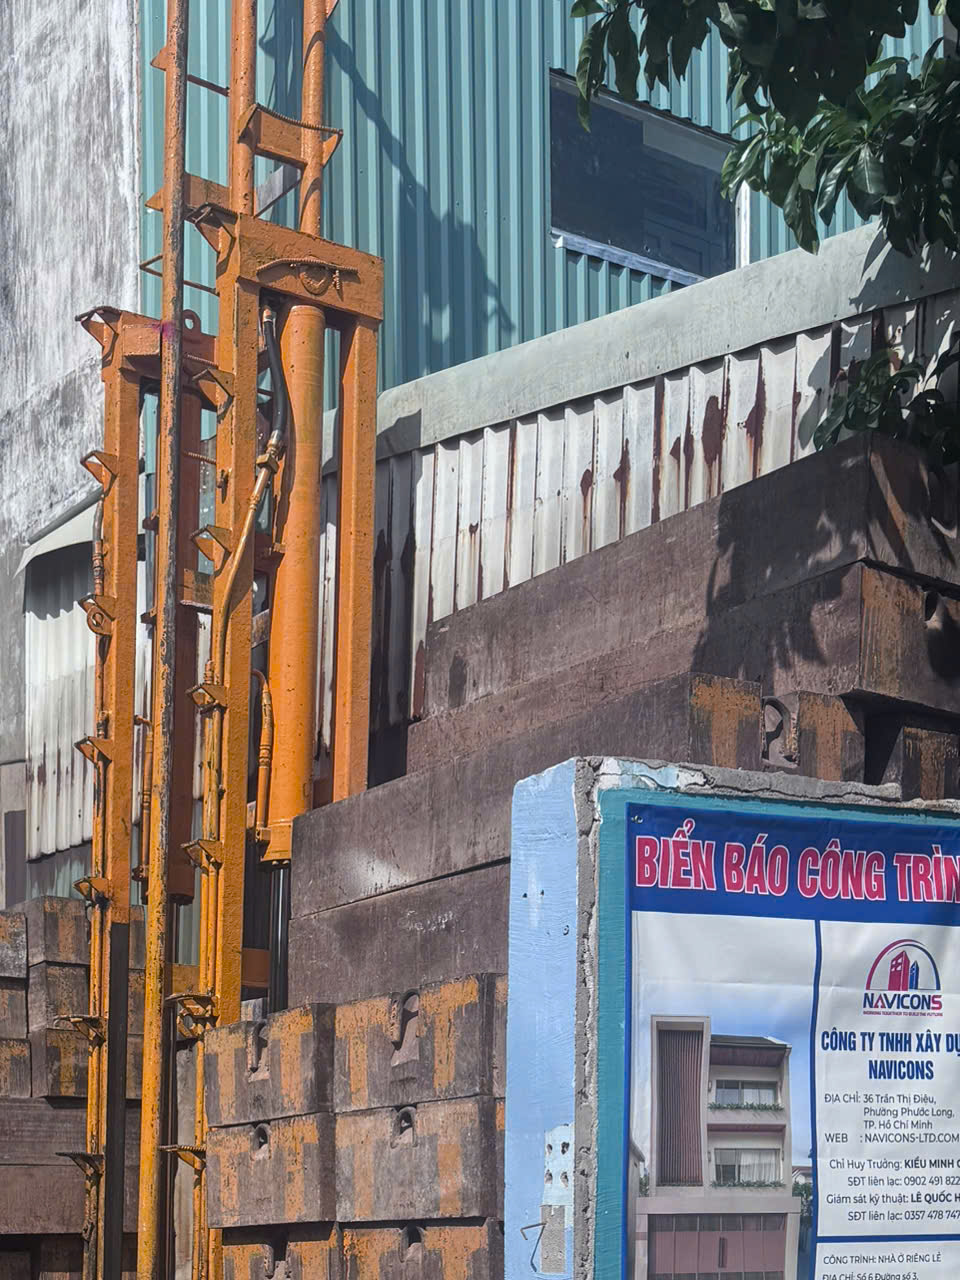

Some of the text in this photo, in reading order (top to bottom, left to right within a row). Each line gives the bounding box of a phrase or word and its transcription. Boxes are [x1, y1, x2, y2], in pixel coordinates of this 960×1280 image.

[635, 818, 716, 891] BIỂN
[723, 833, 789, 896] BÁO
[796, 839, 887, 901] CÔNG
[863, 993, 943, 1011] NAVICONS
[821, 1027, 856, 1051] CÔNG
[860, 1032, 875, 1052] TY
[879, 1032, 912, 1052] TNHH
[916, 1029, 941, 1052] XÂY
[868, 1060, 934, 1080] NAVICONS
[824, 1091, 936, 1105] ĐỊA CHỈ: 36 Trần Thị Điệu,
[863, 1107, 955, 1118] Phường Phước Long,
[863, 1120, 933, 1130] TP. Hồ Chí Minh
[825, 1133, 848, 1143] WEB
[829, 1158, 844, 1169] Chỉ
[847, 1159, 865, 1171] Huy
[929, 1159, 954, 1169] MINH
[847, 1176, 866, 1186] SĐT
[868, 1176, 884, 1186] liên
[886, 1176, 902, 1187] lạc:
[904, 1176, 926, 1185] 0902
[929, 1176, 943, 1185] 491
[826, 1193, 851, 1204] Giám
[853, 1193, 866, 1204] sát
[869, 1193, 880, 1206] kỹ
[881, 1194, 908, 1206] thuật:
[911, 1191, 921, 1203] LÊ
[924, 1190, 952, 1204] QUỐC
[847, 1211, 866, 1221] SĐT
[868, 1211, 885, 1221] liên
[887, 1211, 903, 1222] lạc:
[904, 1210, 925, 1221] 0357
[927, 1210, 943, 1220] 478
[823, 1254, 848, 1265] CÔNG
[878, 1252, 896, 1263] NHÀ
[906, 1253, 930, 1263] RIÊNG
[868, 1273, 873, 1280] 6
